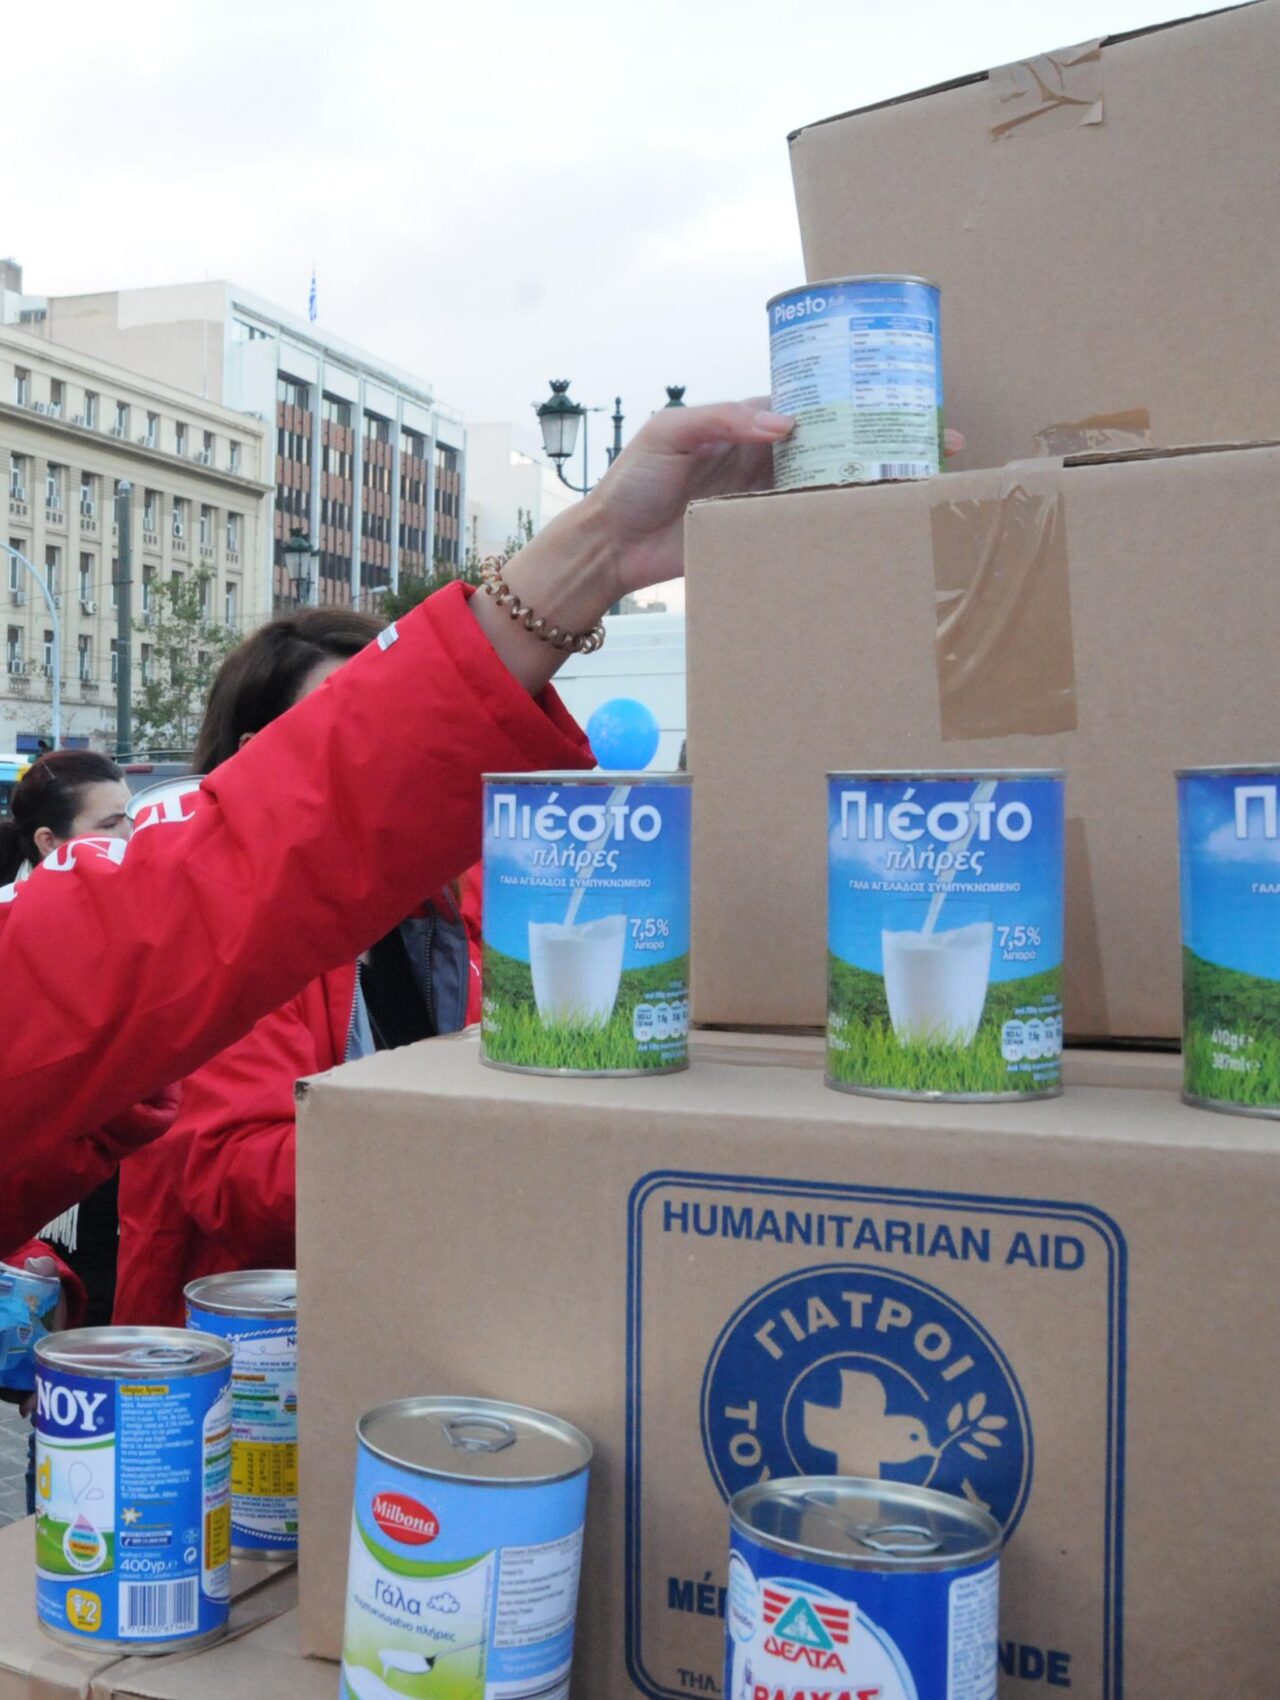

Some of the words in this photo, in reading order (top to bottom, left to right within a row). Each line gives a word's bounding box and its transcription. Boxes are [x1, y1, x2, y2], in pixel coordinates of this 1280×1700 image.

[774, 297, 827, 325] Piesto
[493, 792, 662, 842] Πιέστο
[840, 787, 1033, 842] Πιέστο
[532, 843, 619, 872] πλήρες
[885, 844, 985, 875] πλήρες
[871, 880, 926, 892] ΑΓΕΛΑΔΟΣ
[928, 881, 1021, 893] ΣΥΜΠΥΚΝΩΜΕΝΟ
[630, 918, 669, 941] 7,5%
[996, 926, 1041, 949] 7,5%
[663, 1201, 990, 1263] HUMANITARIAN
[1005, 1232, 1086, 1271] AID
[753, 1291, 975, 1382] ΓΙΑΤΡΟΙ
[373, 1496, 436, 1535] Milbona
[86, 1600, 98, 1623] 2
[374, 1579, 422, 1617] Γάλα
[416, 1624, 456, 1643] πλήρες
[763, 1636, 847, 1674] ΔΕΛΤΑ
